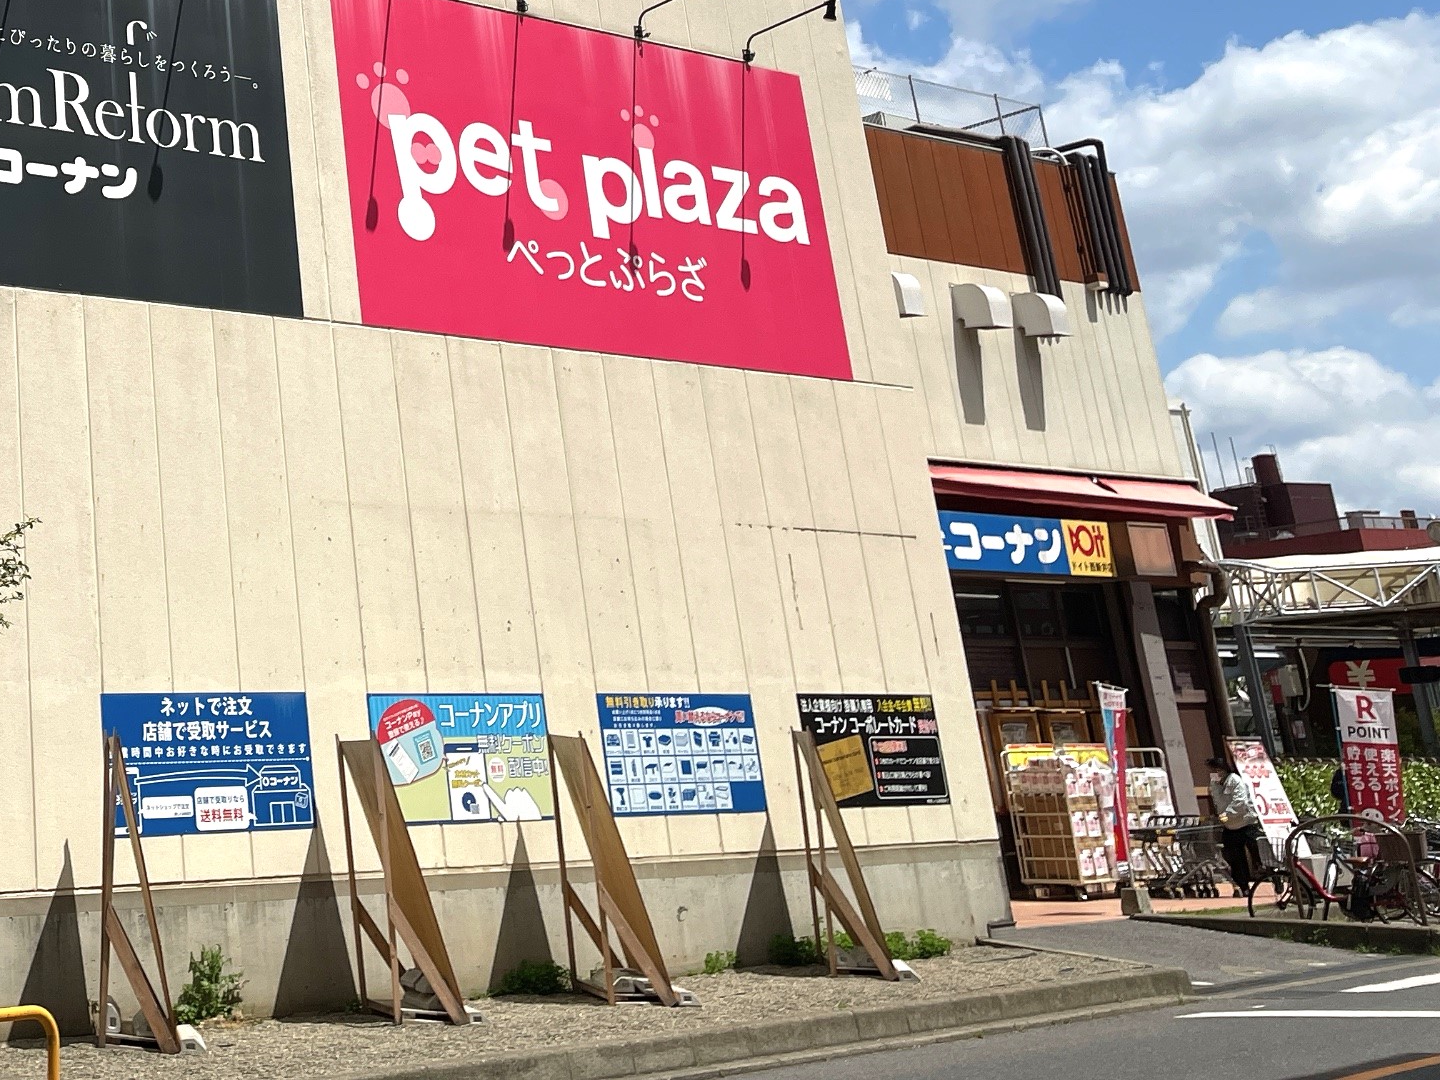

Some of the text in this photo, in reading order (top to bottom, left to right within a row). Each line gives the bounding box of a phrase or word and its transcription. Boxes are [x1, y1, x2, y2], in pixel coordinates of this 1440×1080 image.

[388, 112, 811, 246] pet plaza
[507, 240, 708, 303] ぺっとぷらざ
[949, 521, 1061, 565] コーナン
[160, 696, 253, 717] ネットで注文
[439, 701, 542, 729] コーナンアプリ
[142, 720, 272, 742] 店舗で受取サービス
[476, 733, 546, 754] 無料クーポン
[1348, 726, 1391, 740] POINT
[109, 743, 307, 760] 業時間中お好きな時にお受取できます
[1380, 749, 1402, 822] 楽天ポイン
